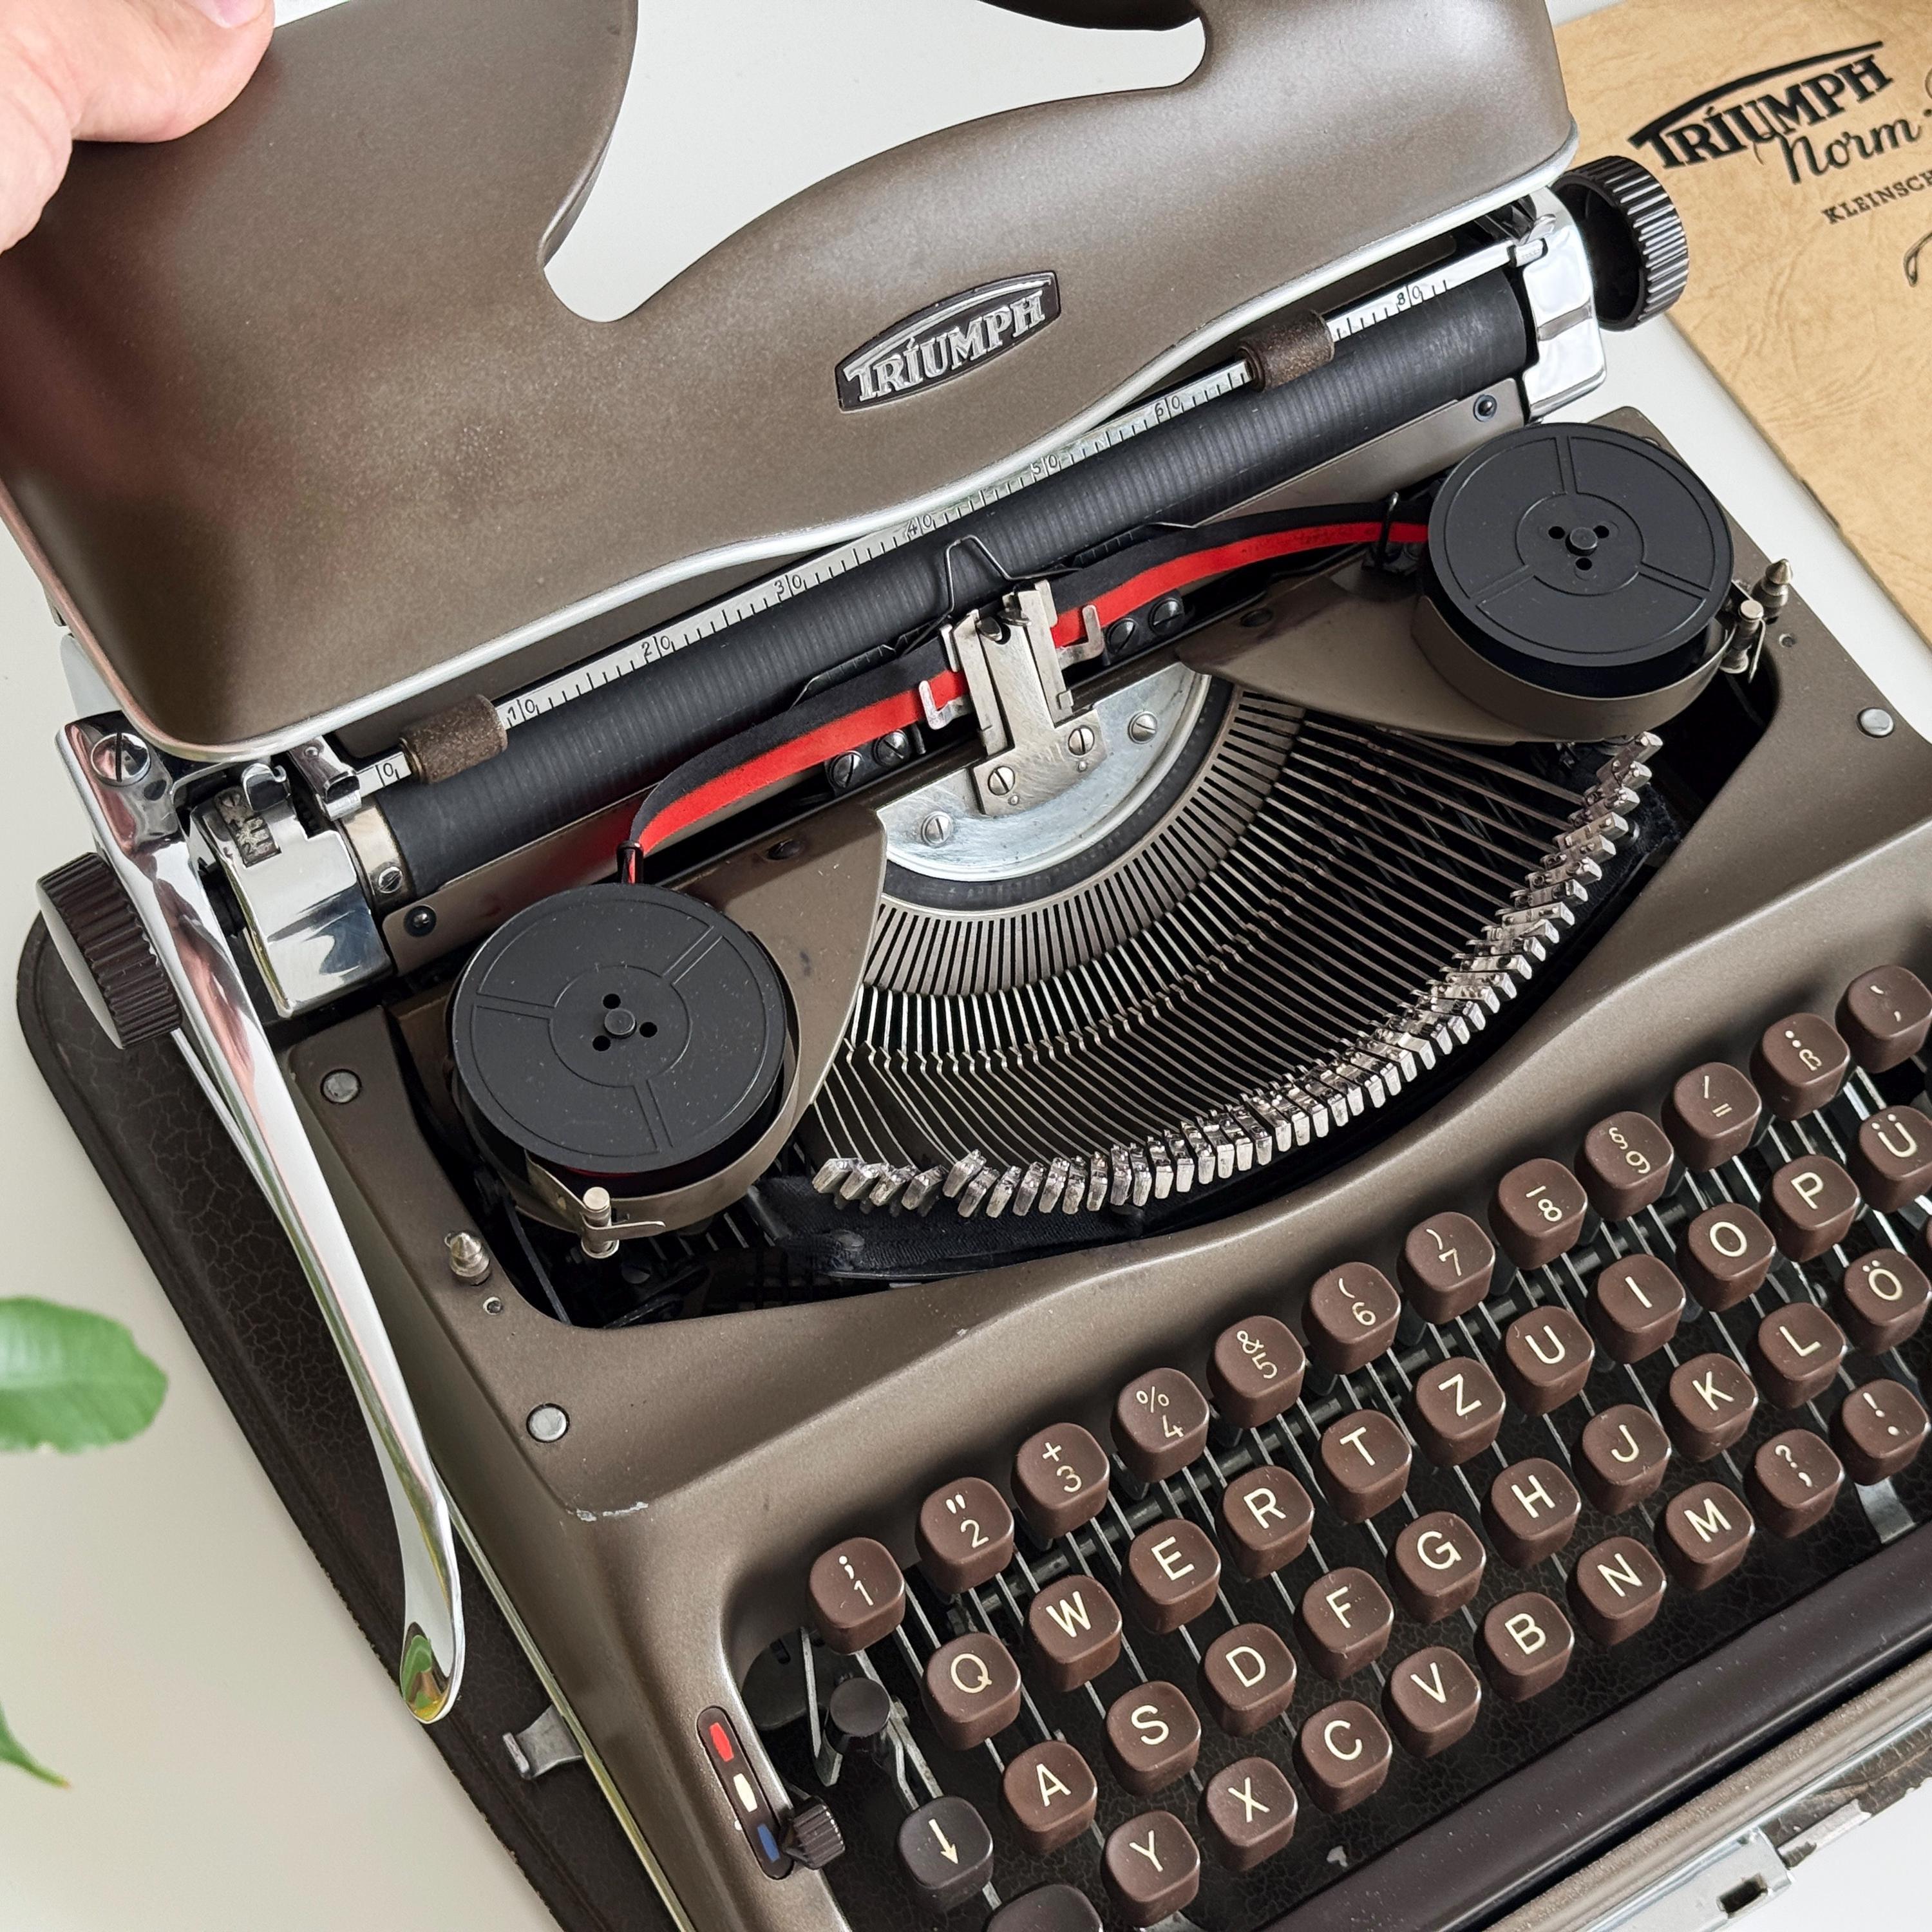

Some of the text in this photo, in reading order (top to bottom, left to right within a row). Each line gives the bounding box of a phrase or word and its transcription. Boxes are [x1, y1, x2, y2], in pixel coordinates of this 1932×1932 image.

[507, 699, 535, 720] 10
[641, 636, 670, 657] 20
[774, 574, 802, 594] 30
[908, 515, 932, 535] 40
[1032, 454, 1057, 475] 50
[1155, 395, 1180, 417] 60
[1397, 285, 1421, 305] 80
[1609, 1127, 1629, 1150] §
[1871, 1113, 1917, 1157] Ü
[1625, 1151, 1651, 1174] 9
[1538, 1198, 1562, 1222] 8
[1790, 1172, 1823, 1209] P
[1709, 1222, 1747, 1257] O
[1438, 1248, 1462, 1276] 7
[1862, 1260, 1902, 1301] Ö
[1625, 1276, 1653, 1308] I
[1352, 1302, 1376, 1325] 6
[1236, 1330, 1264, 1354] &
[1524, 1325, 1566, 1364] U
[1779, 1326, 1821, 1357] L
[1252, 1352, 1278, 1379] 5
[1136, 1386, 1170, 1413] %
[1438, 1373, 1482, 1417] Z
[1692, 1370, 1734, 1411] K
[1162, 1415, 1184, 1438] 4
[1340, 1426, 1376, 1466] T
[1611, 1425, 1639, 1463] J
[1056, 1465, 1082, 1492] 3
[1511, 1475, 1555, 1519] H
[1244, 1488, 1286, 1529] R
[1683, 1498, 1732, 1542] M
[960, 1519, 989, 1548] 2
[1417, 1531, 1462, 1570] G
[1151, 1536, 1195, 1581] E
[1597, 1553, 1642, 1597] N
[853, 1580, 874, 1605] 1
[1326, 1586, 1351, 1629] F
[1045, 1591, 1091, 1638] W
[1504, 1613, 1546, 1654] B
[951, 1653, 992, 1694] Q
[1226, 1646, 1266, 1688] D
[1410, 1662, 1446, 1703] V
[1131, 1705, 1169, 1745] S
[1324, 1720, 1363, 1761] C
[1036, 1763, 1071, 1807] A
[1227, 1777, 1270, 1823] X
[1129, 1830, 1163, 1872] Y
